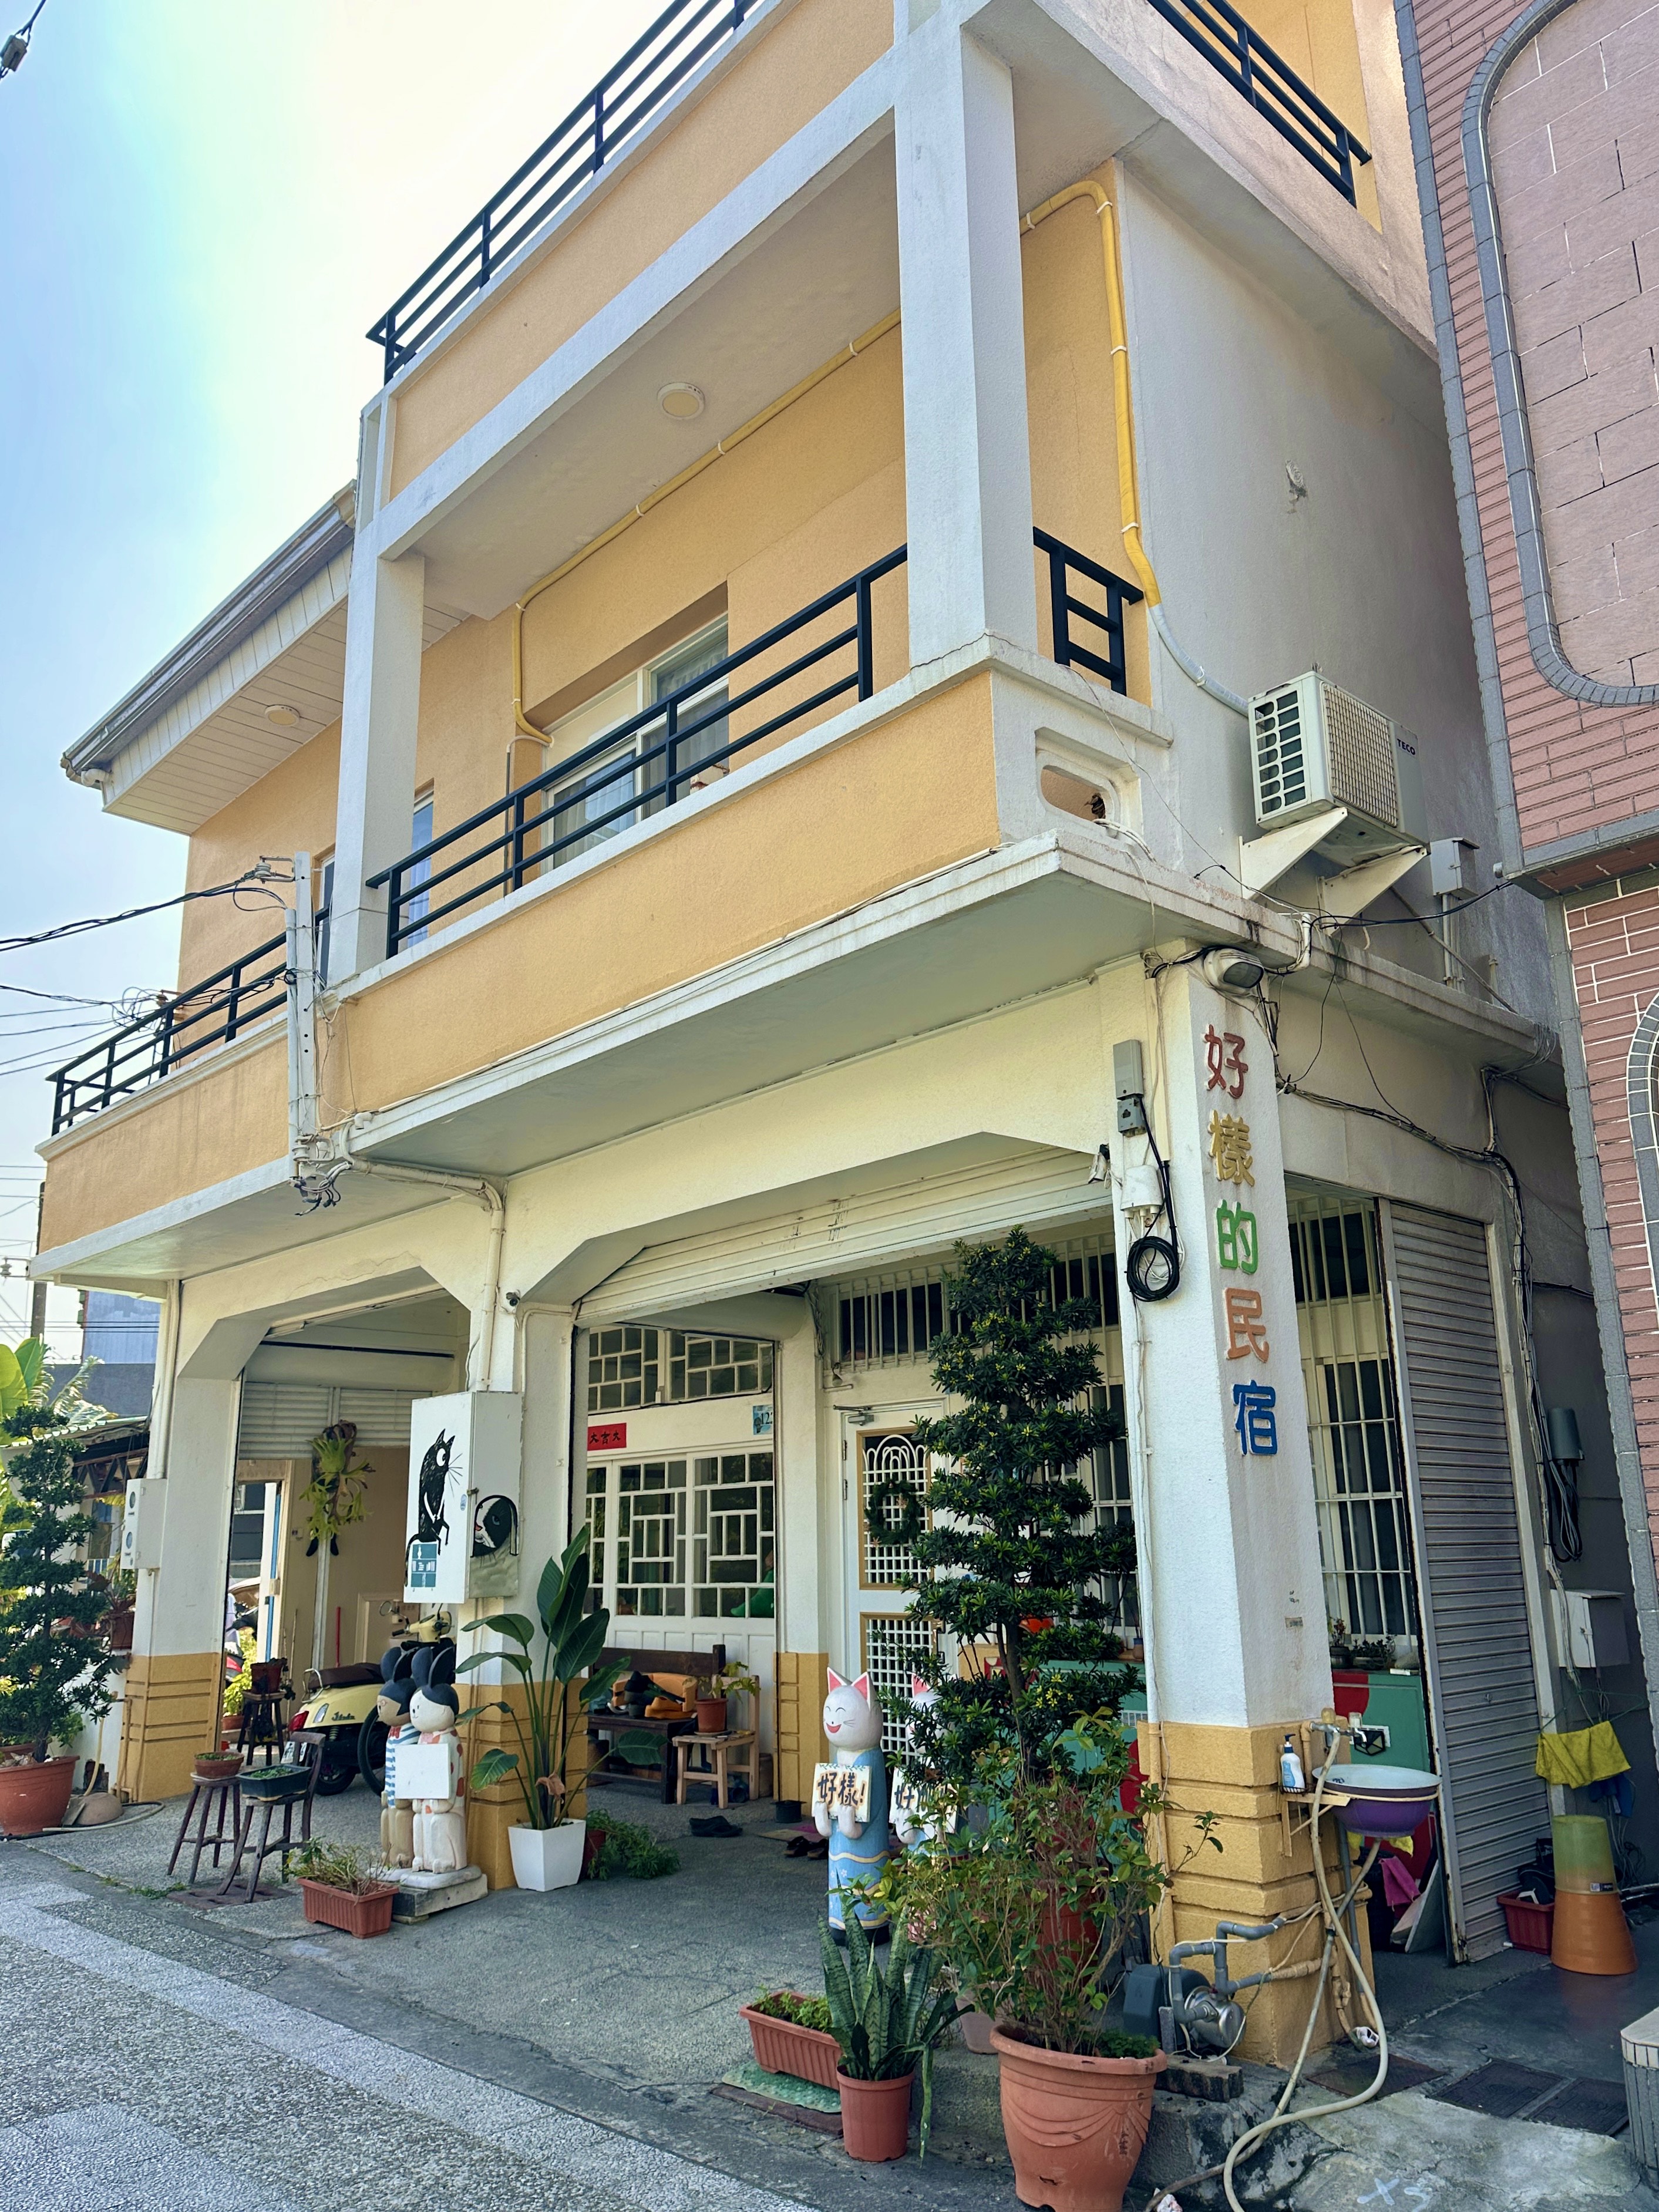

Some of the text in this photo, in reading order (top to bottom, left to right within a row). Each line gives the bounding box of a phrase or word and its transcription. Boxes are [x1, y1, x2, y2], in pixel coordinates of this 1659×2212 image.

[1396, 738, 1415, 755] TECO
[1204, 1024, 1277, 1456] 好樣的民宿
